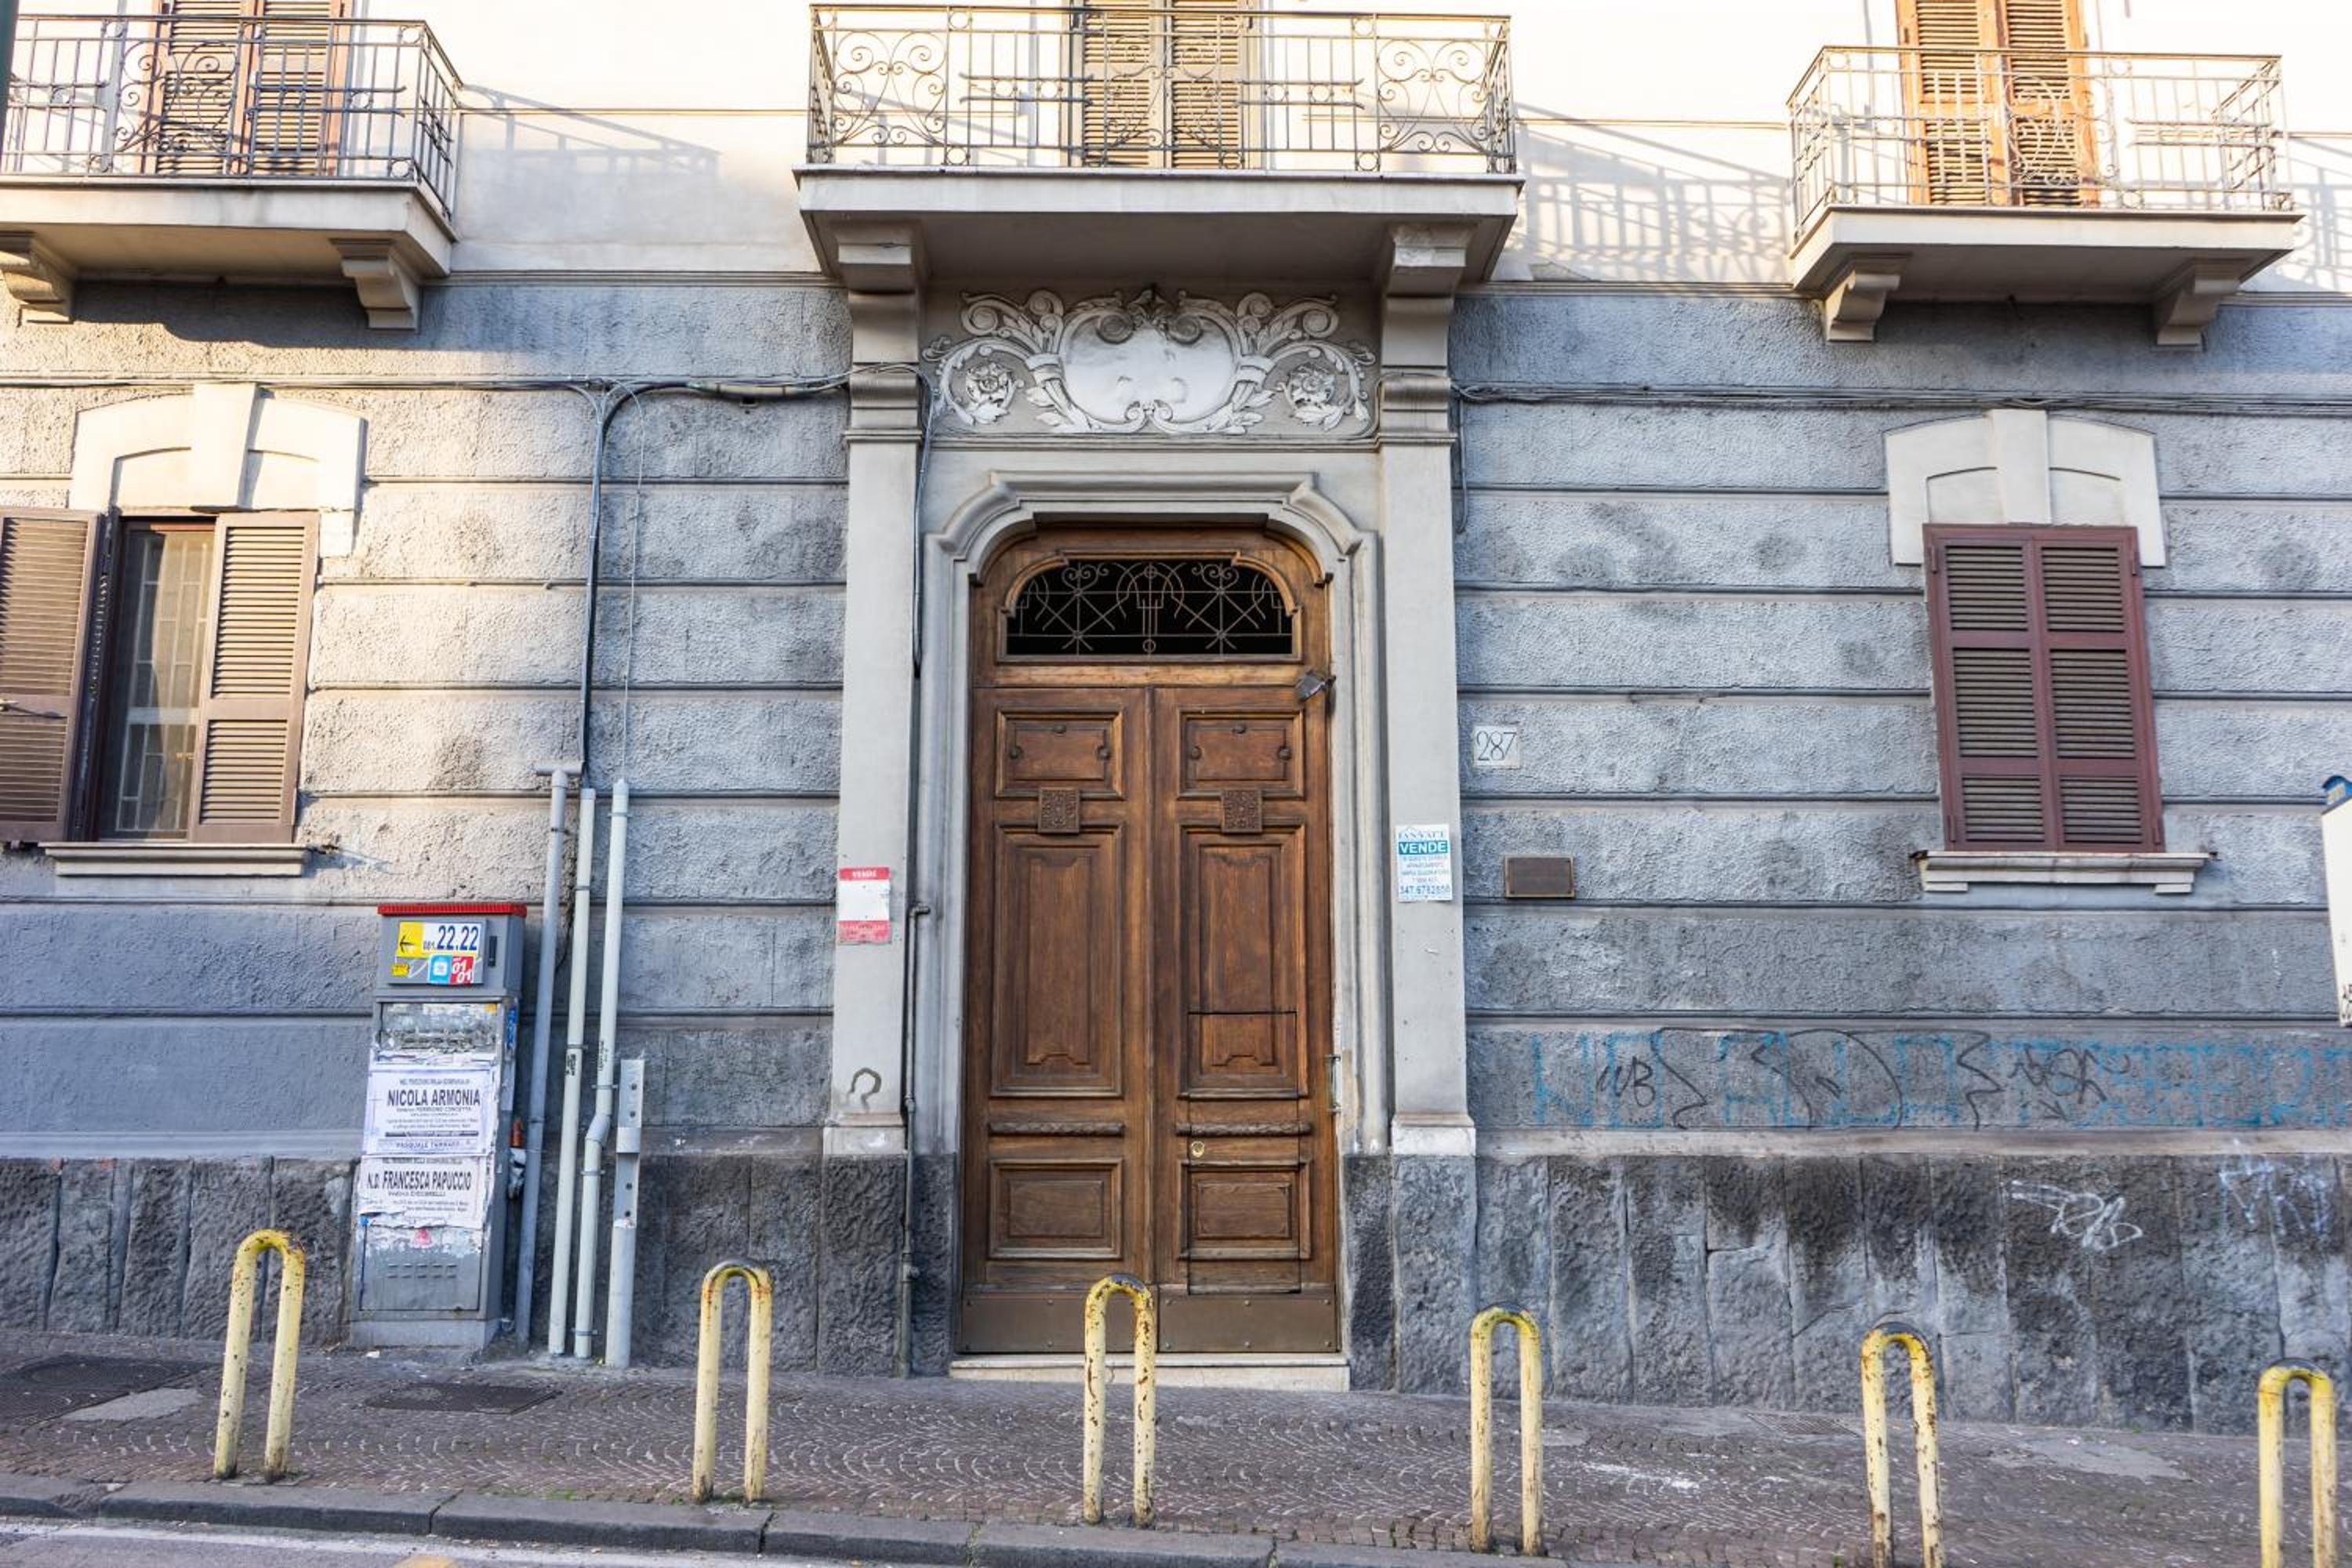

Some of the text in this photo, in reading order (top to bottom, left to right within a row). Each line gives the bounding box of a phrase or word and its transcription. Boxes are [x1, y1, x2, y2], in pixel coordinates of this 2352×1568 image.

[1475, 730, 1517, 761] 287
[1399, 841, 1446, 854] VENDE
[387, 1088, 481, 1106] NICOLA ARMONIA
[382, 1171, 430, 1190] FRANCESCA
[432, 1171, 472, 1191] PAPUCCIO
